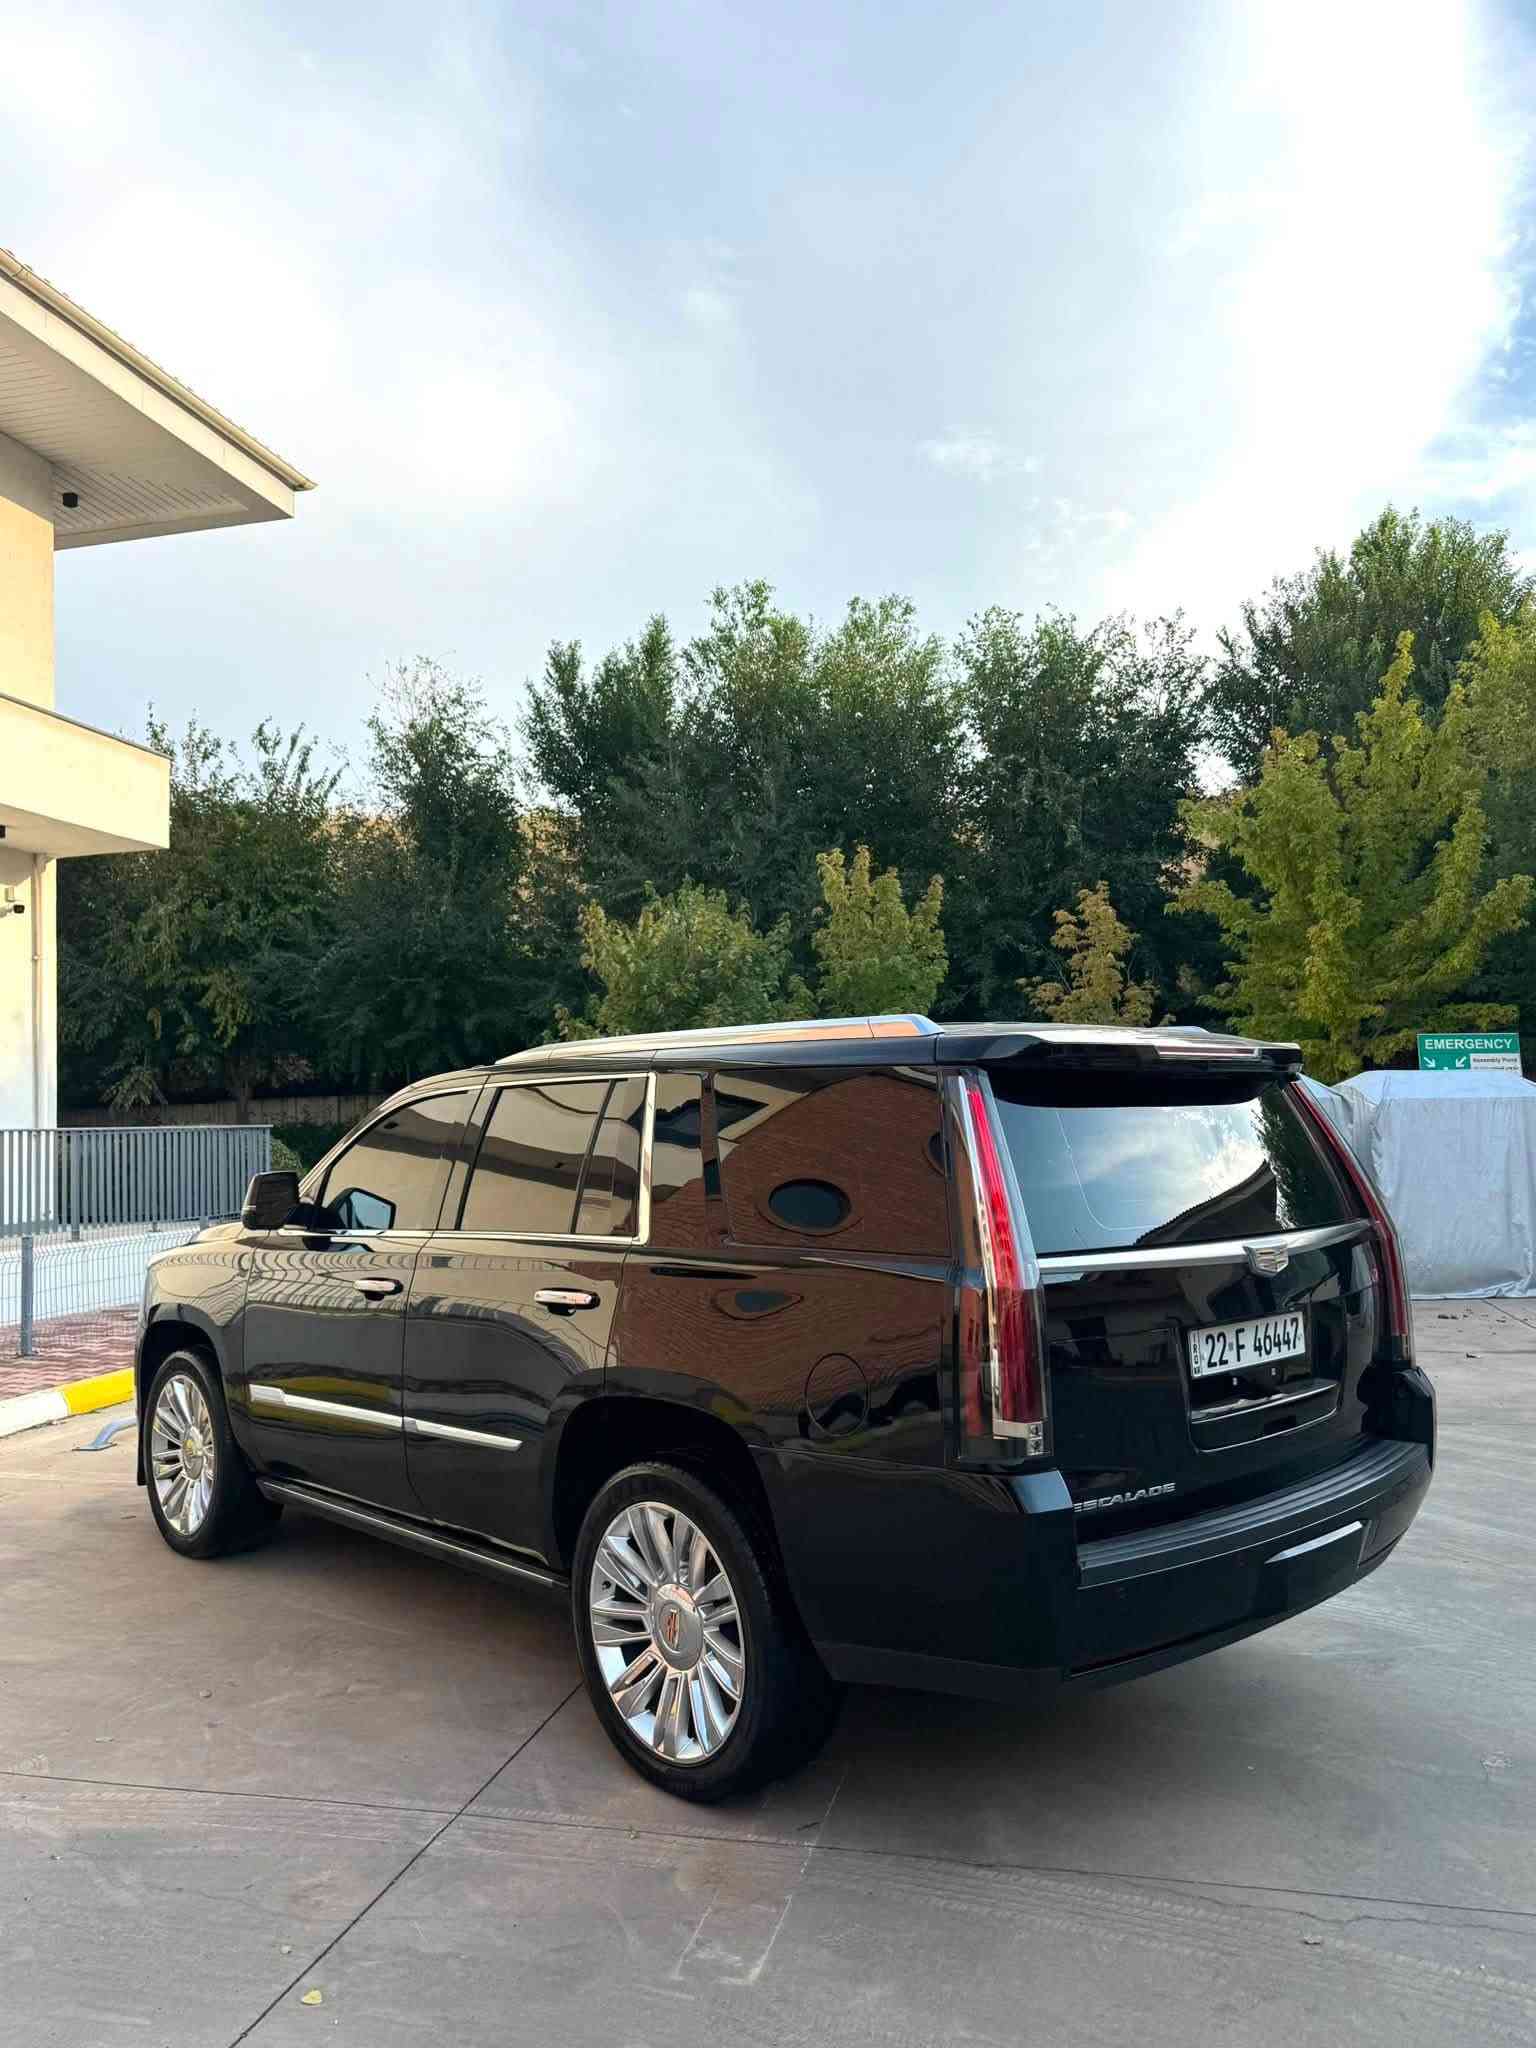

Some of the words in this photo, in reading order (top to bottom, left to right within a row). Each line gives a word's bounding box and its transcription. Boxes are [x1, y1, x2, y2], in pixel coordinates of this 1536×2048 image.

[1425, 1039, 1512, 1049] EMERGENCY
[1205, 1331, 1229, 1368] 22
[1235, 1328, 1245, 1362] F
[1253, 1317, 1299, 1357] 46447
[1073, 1482, 1176, 1513] ESCALADE
